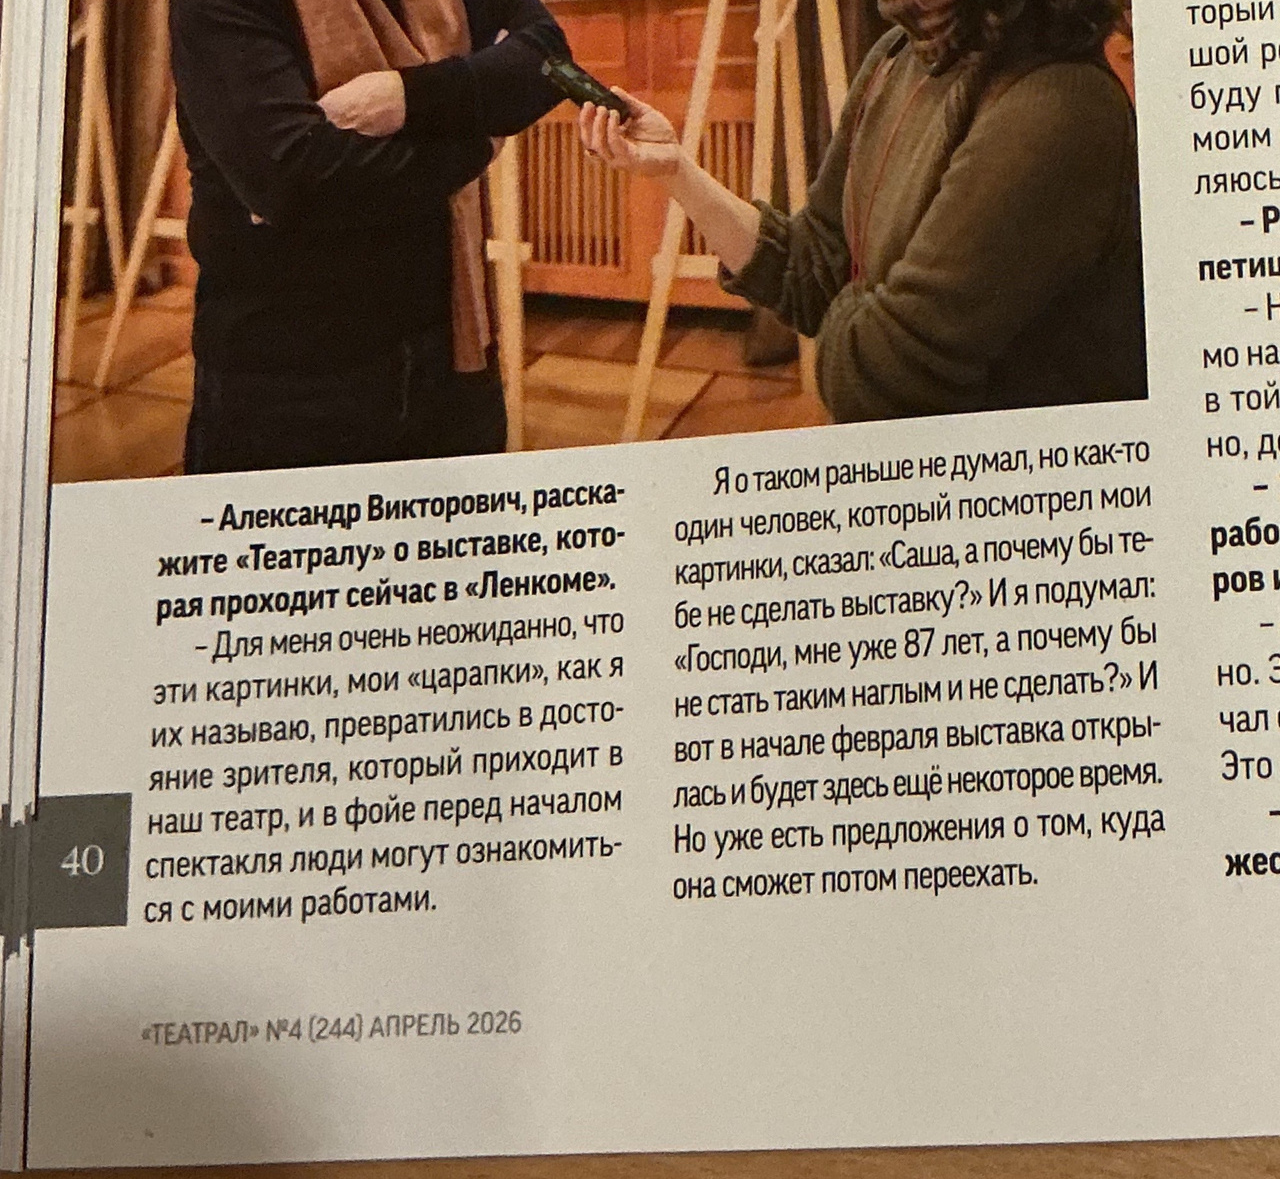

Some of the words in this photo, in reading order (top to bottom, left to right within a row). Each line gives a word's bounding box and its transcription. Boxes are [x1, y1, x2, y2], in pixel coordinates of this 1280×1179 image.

[1192, 126, 1272, 153] моим
[674, 516, 734, 547] один
[739, 508, 842, 537] человек,
[847, 491, 952, 532] который
[958, 489, 1094, 522] посмотрел
[1100, 484, 1152, 510] мои
[156, 552, 229, 578] жите
[235, 543, 387, 575] «Театралу»
[393, 541, 410, 563] о
[417, 531, 549, 561] выставке,
[556, 526, 626, 551] кото-
[155, 596, 204, 627] рая
[209, 588, 341, 623] проходит
[345, 577, 438, 608] сейчас
[443, 580, 459, 602] в
[464, 569, 617, 600] «Ленкоме».
[673, 642, 788, 675] «Господи,
[794, 641, 842, 666] мне
[847, 637, 898, 670] уже
[903, 626, 936, 659] 87
[940, 631, 989, 659] лет,
[995, 630, 1012, 653] а
[1017, 624, 1114, 655] почему
[1120, 614, 1158, 646] бы
[152, 682, 198, 706] эти
[205, 674, 340, 708] картинки,
[347, 670, 400, 695] мои
[407, 662, 549, 695] «царапки»,
[556, 657, 603, 682] как
[608, 655, 624, 678] я
[60, 844, 105, 878] 40
[672, 875, 718, 901] она
[722, 871, 816, 898] сможет
[821, 868, 897, 895] потом
[903, 862, 1039, 898] переехать.
[143, 900, 173, 924] ся
[180, 899, 196, 923] с
[202, 895, 293, 922] моими
[300, 885, 438, 925] работами.
[140, 1019, 260, 1047] «ТЕАТРАЛ»
[265, 1017, 303, 1043] №4
[307, 1012, 364, 1045] (244)
[367, 1012, 461, 1040] АПРЕЛЬ
[466, 1009, 523, 1036] 2026
